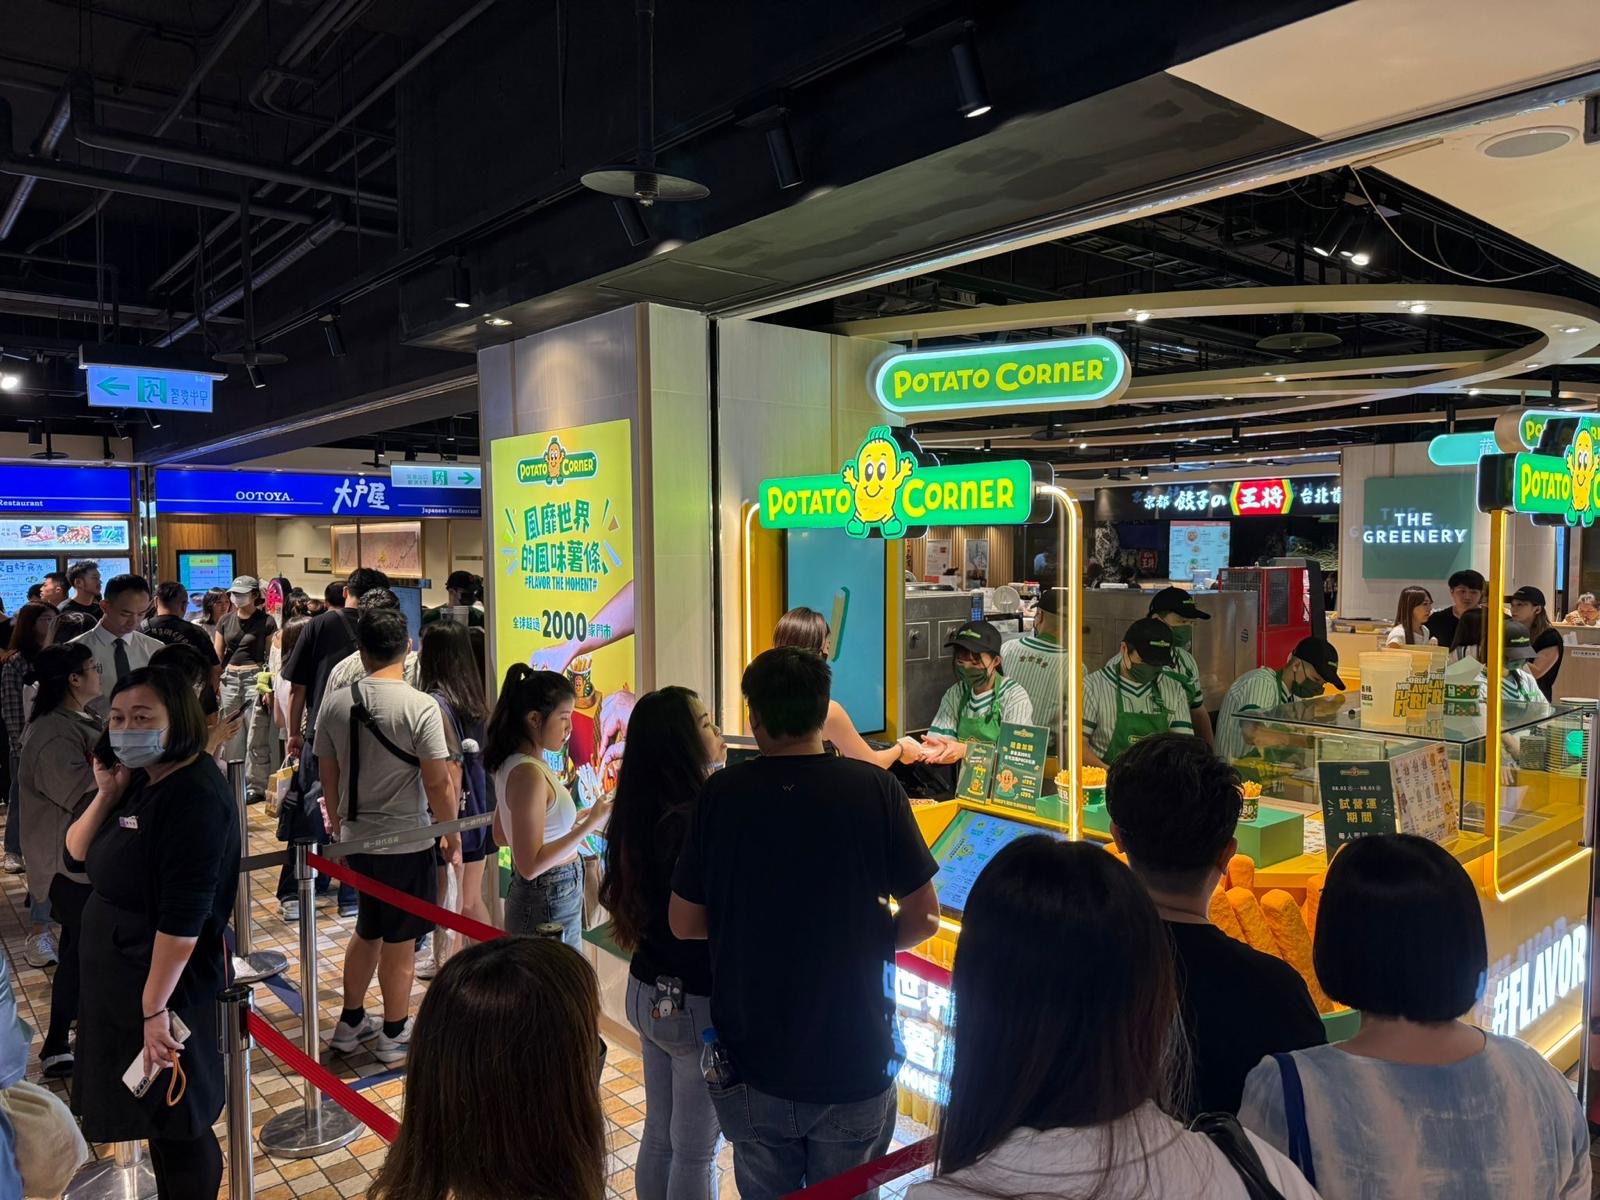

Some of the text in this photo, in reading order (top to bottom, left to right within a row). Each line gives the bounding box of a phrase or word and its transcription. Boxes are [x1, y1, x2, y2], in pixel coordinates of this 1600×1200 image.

[893, 367, 990, 399] POTATO
[995, 359, 1104, 392] CORNER
[171, 396, 208, 407] EXIT
[519, 457, 594, 480] POTATO CORNER
[1521, 463, 1570, 504] POTATO
[767, 478, 1015, 521] POTATO CORNER
[1143, 495, 1170, 510] 京都
[524, 499, 590, 541] 風靡世界
[1394, 512, 1433, 527] THE
[1362, 528, 1468, 543] GREENERY
[552, 577, 564, 591] THE
[1346, 811, 1374, 824] 期間
[1491, 924, 1588, 1036] #FLAVOR
